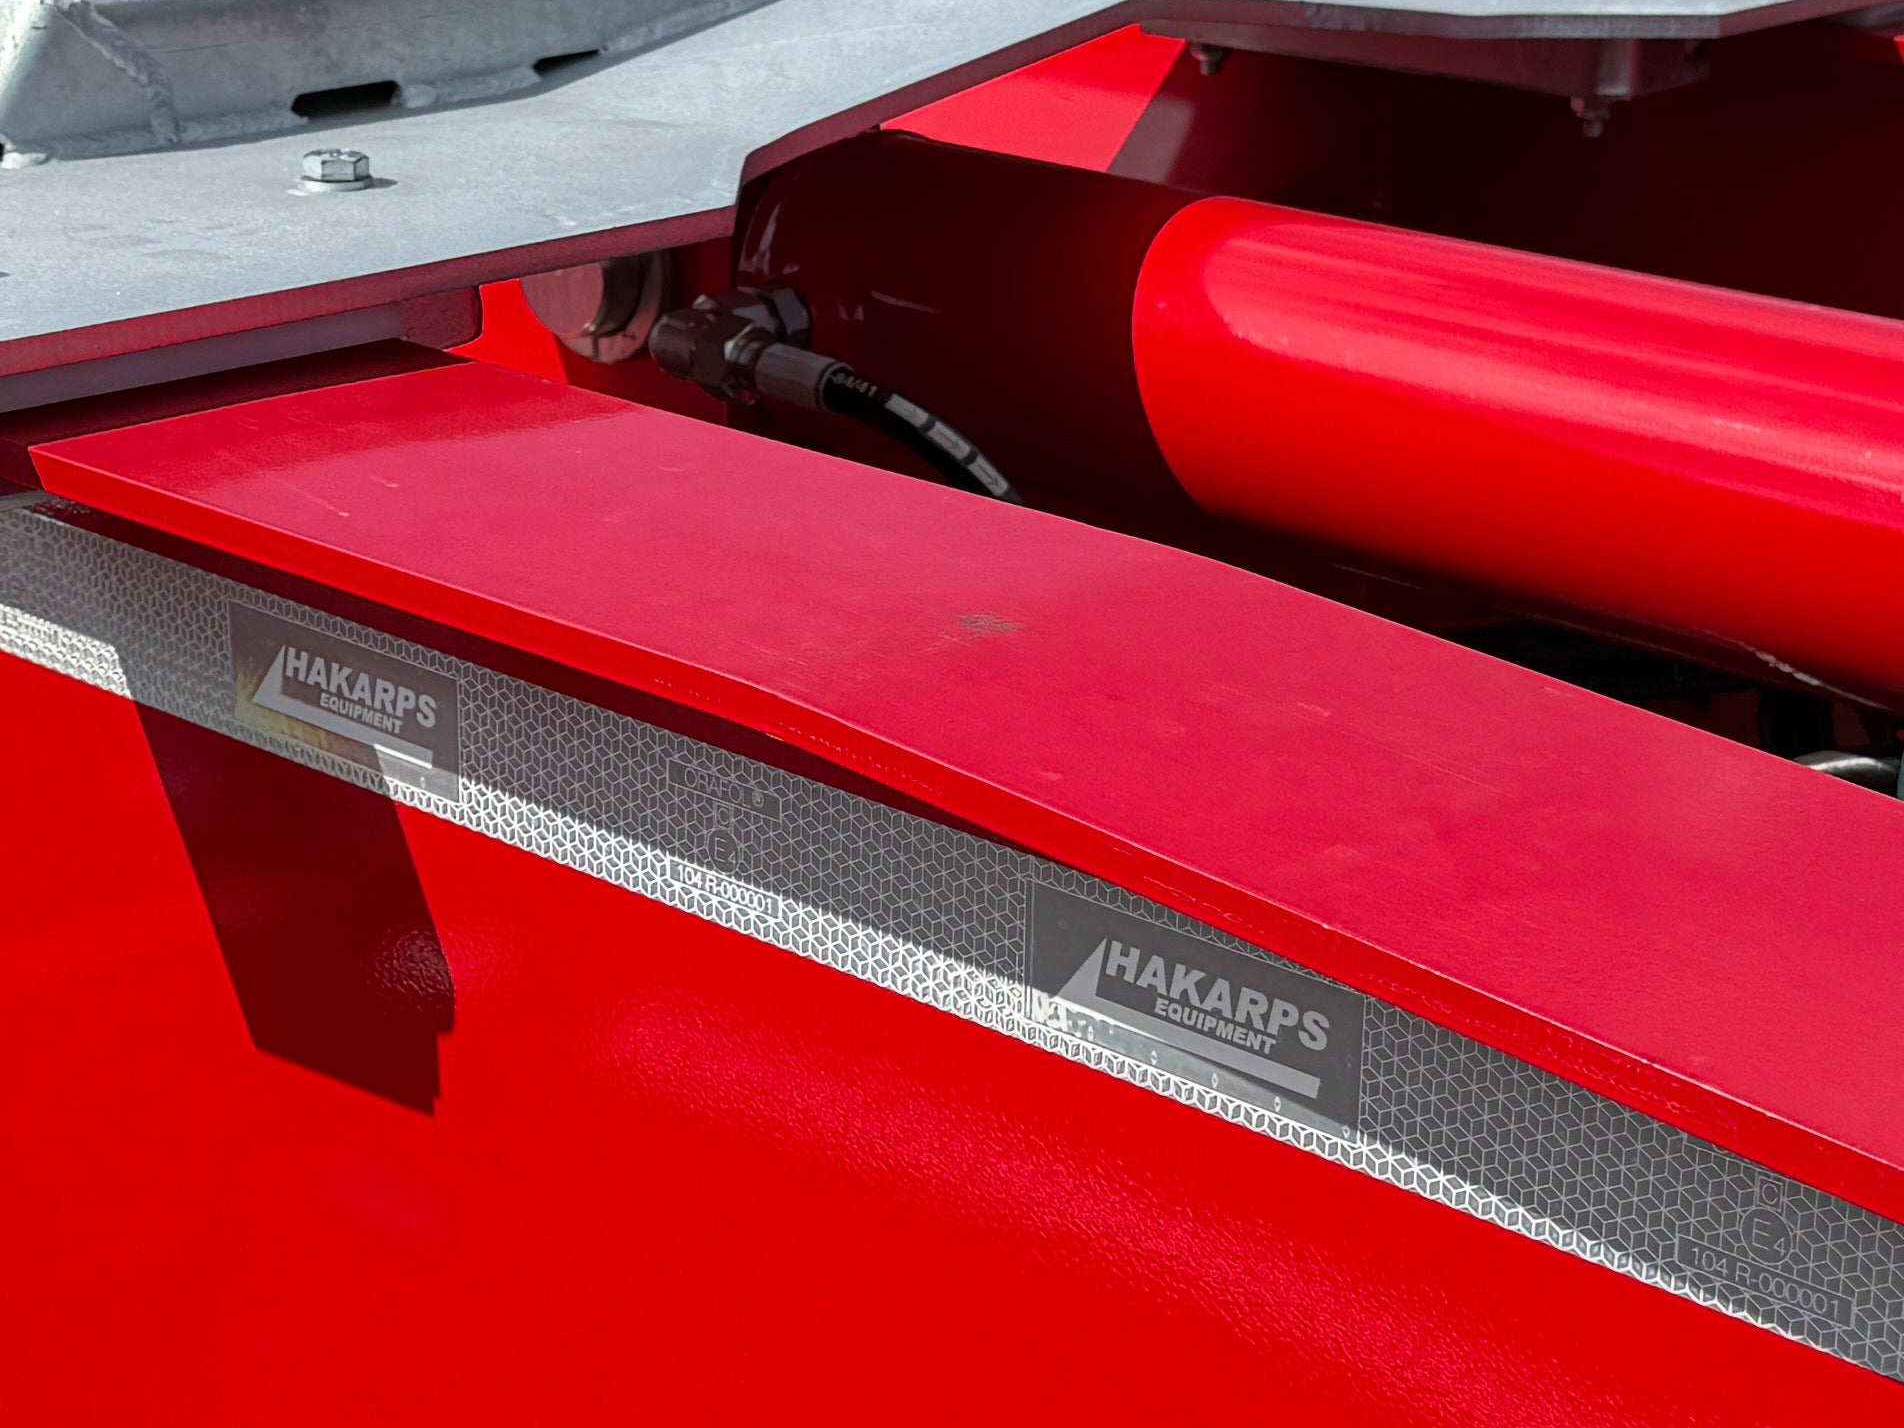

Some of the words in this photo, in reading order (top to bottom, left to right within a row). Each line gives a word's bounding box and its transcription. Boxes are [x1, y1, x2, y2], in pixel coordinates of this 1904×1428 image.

[285, 647, 437, 729] HAKARPS
[320, 692, 403, 735] EQUIPMENT
[677, 865, 702, 887] 104
[1105, 940, 1331, 1052] HAKARPS
[1154, 998, 1277, 1055] EQUIPMENT
[1761, 1183, 1779, 1205] C
[1691, 1247, 1728, 1277] 104
[1735, 1263, 1839, 1319] R-000001
